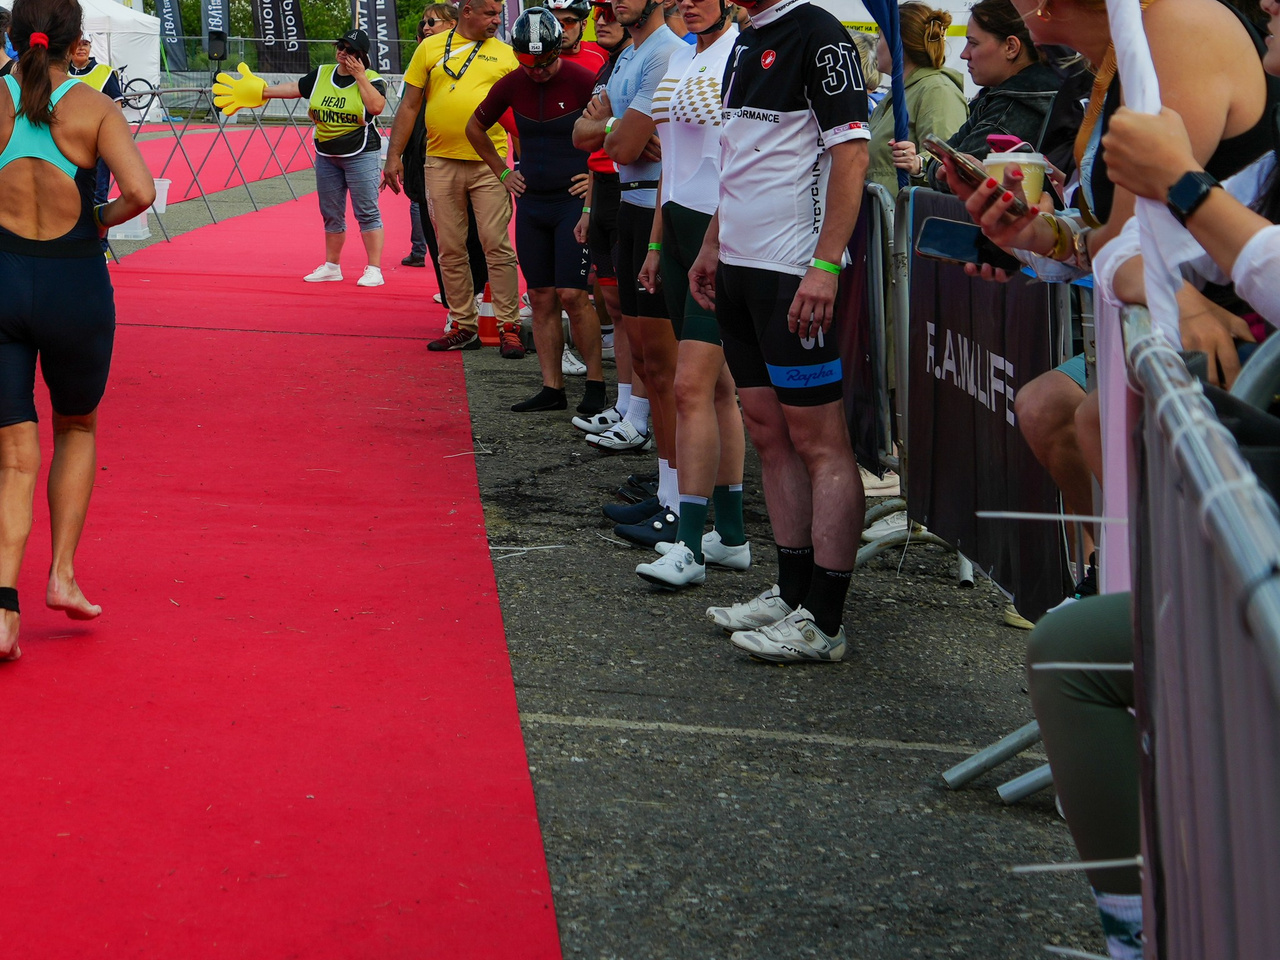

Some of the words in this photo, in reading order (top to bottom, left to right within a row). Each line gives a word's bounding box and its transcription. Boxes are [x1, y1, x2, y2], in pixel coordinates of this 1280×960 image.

[321, 95, 347, 109] HEAD
[312, 108, 359, 124] OLUNTEER
[786, 365, 834, 386] Rapha
